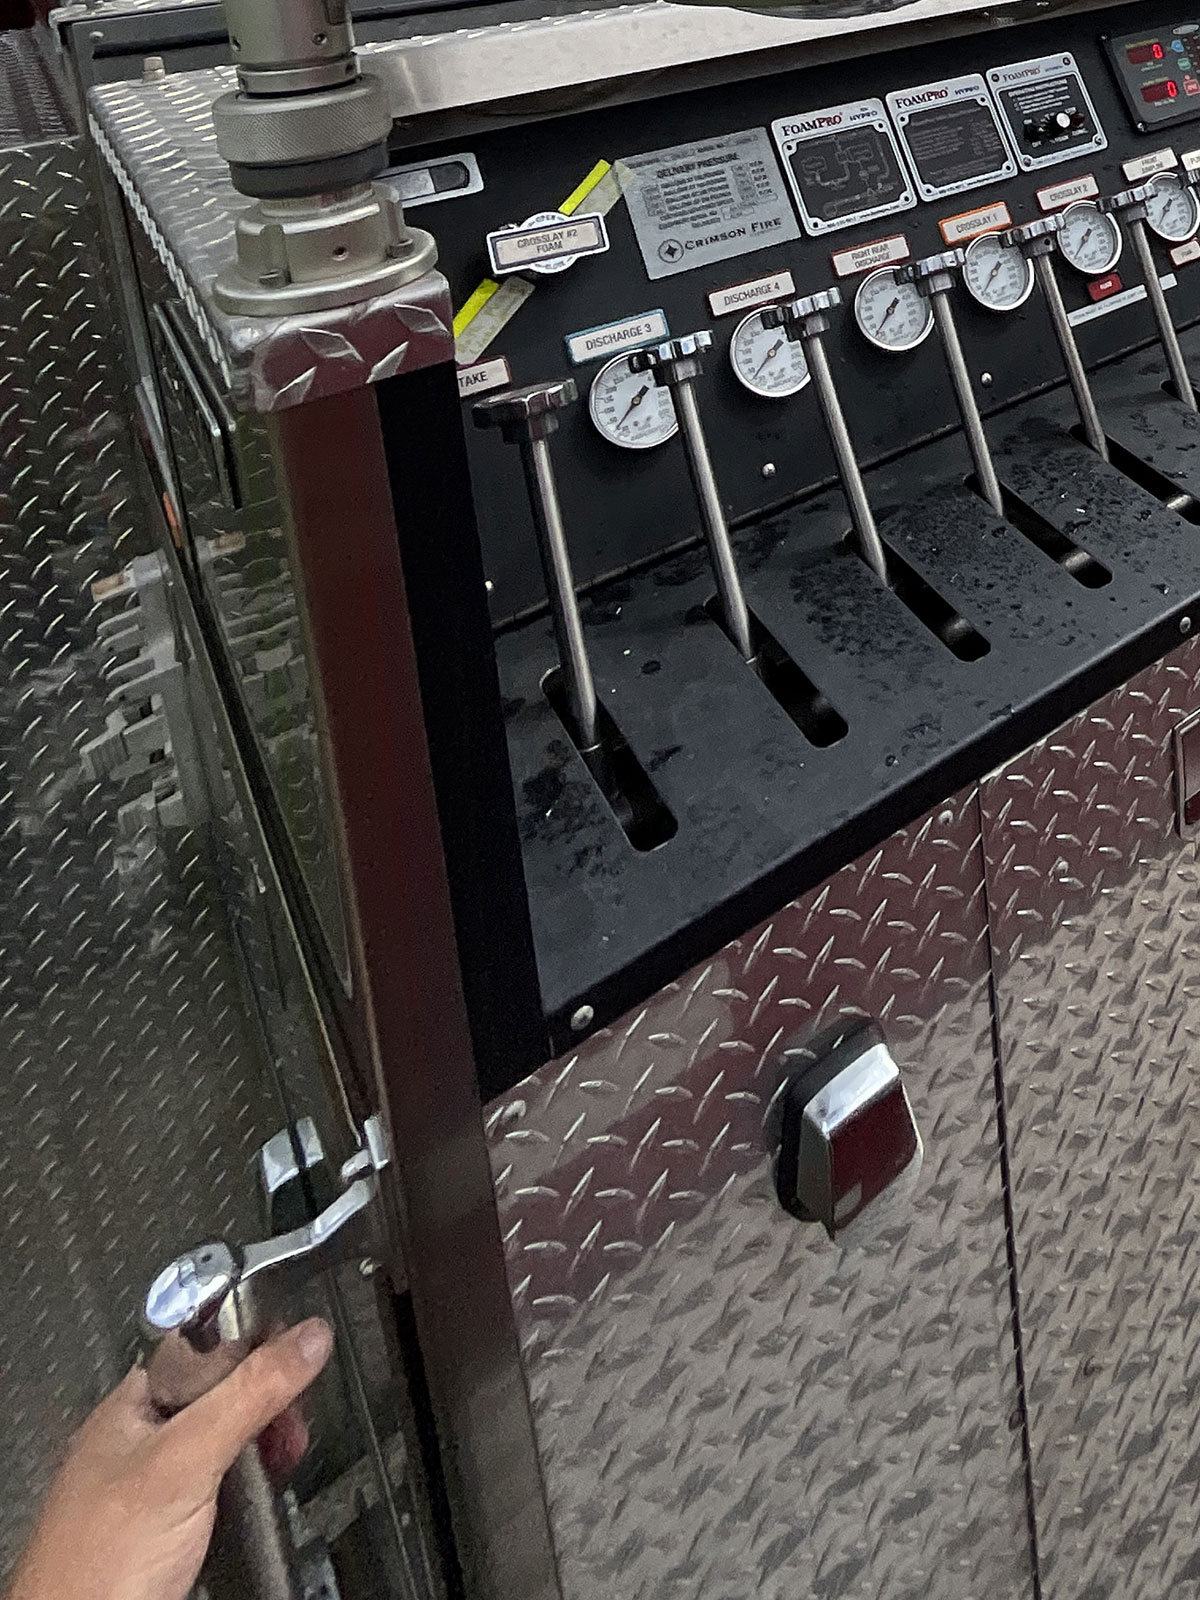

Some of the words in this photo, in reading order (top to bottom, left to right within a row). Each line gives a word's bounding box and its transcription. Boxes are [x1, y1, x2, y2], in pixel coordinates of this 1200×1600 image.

[1050, 186, 1083, 202] CROSSLAY
[685, 227, 746, 250] CRIMSON
[751, 218, 782, 233] FIRE
[955, 217, 992, 234] CROSSLAY
[517, 231, 565, 249] CROSSLAY
[567, 228, 578, 237] #2
[536, 241, 563, 254] FOAM
[851, 248, 871, 260] RIGHT
[872, 243, 889, 255] REAR
[854, 251, 890, 269] DISCHARGE
[723, 285, 773, 306] DISCHARGE
[585, 325, 643, 351] DISCHARGE
[645, 323, 652, 333] 3
